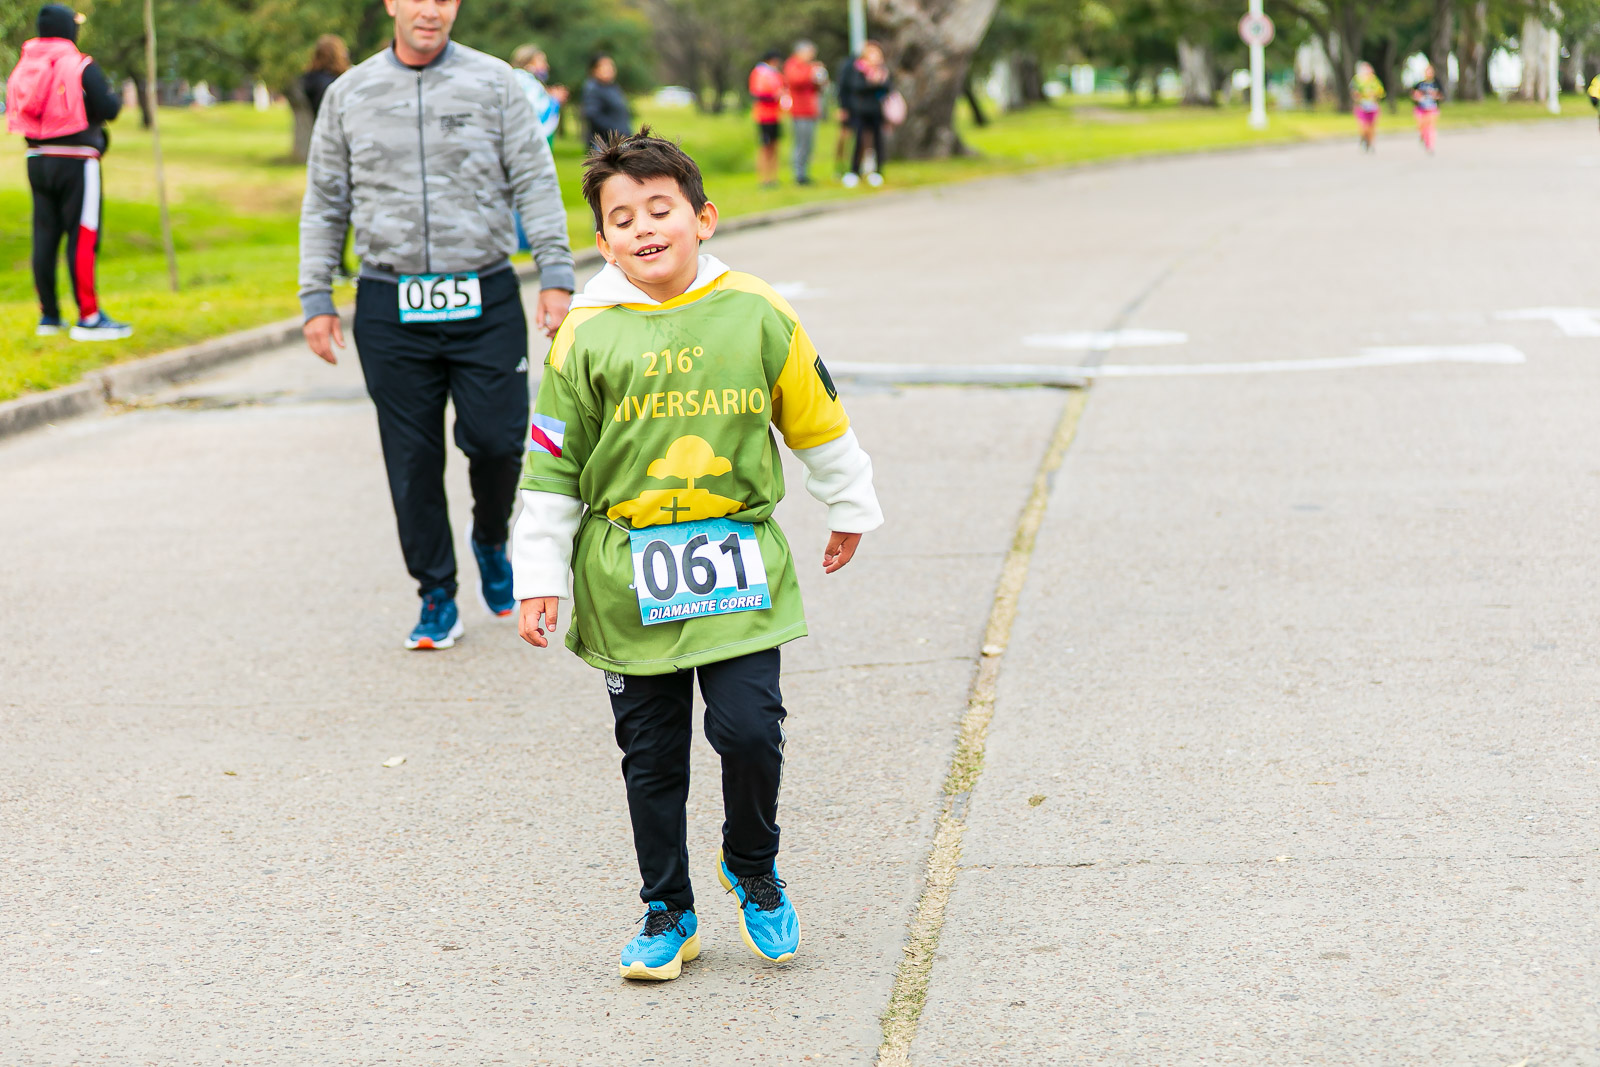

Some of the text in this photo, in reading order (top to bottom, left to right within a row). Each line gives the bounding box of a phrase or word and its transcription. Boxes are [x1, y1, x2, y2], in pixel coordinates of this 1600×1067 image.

[406, 274, 470, 310] 065
[641, 346, 704, 377] 216°
[642, 532, 749, 602] 061
[648, 594, 763, 621] DIAMANTE CORRE
